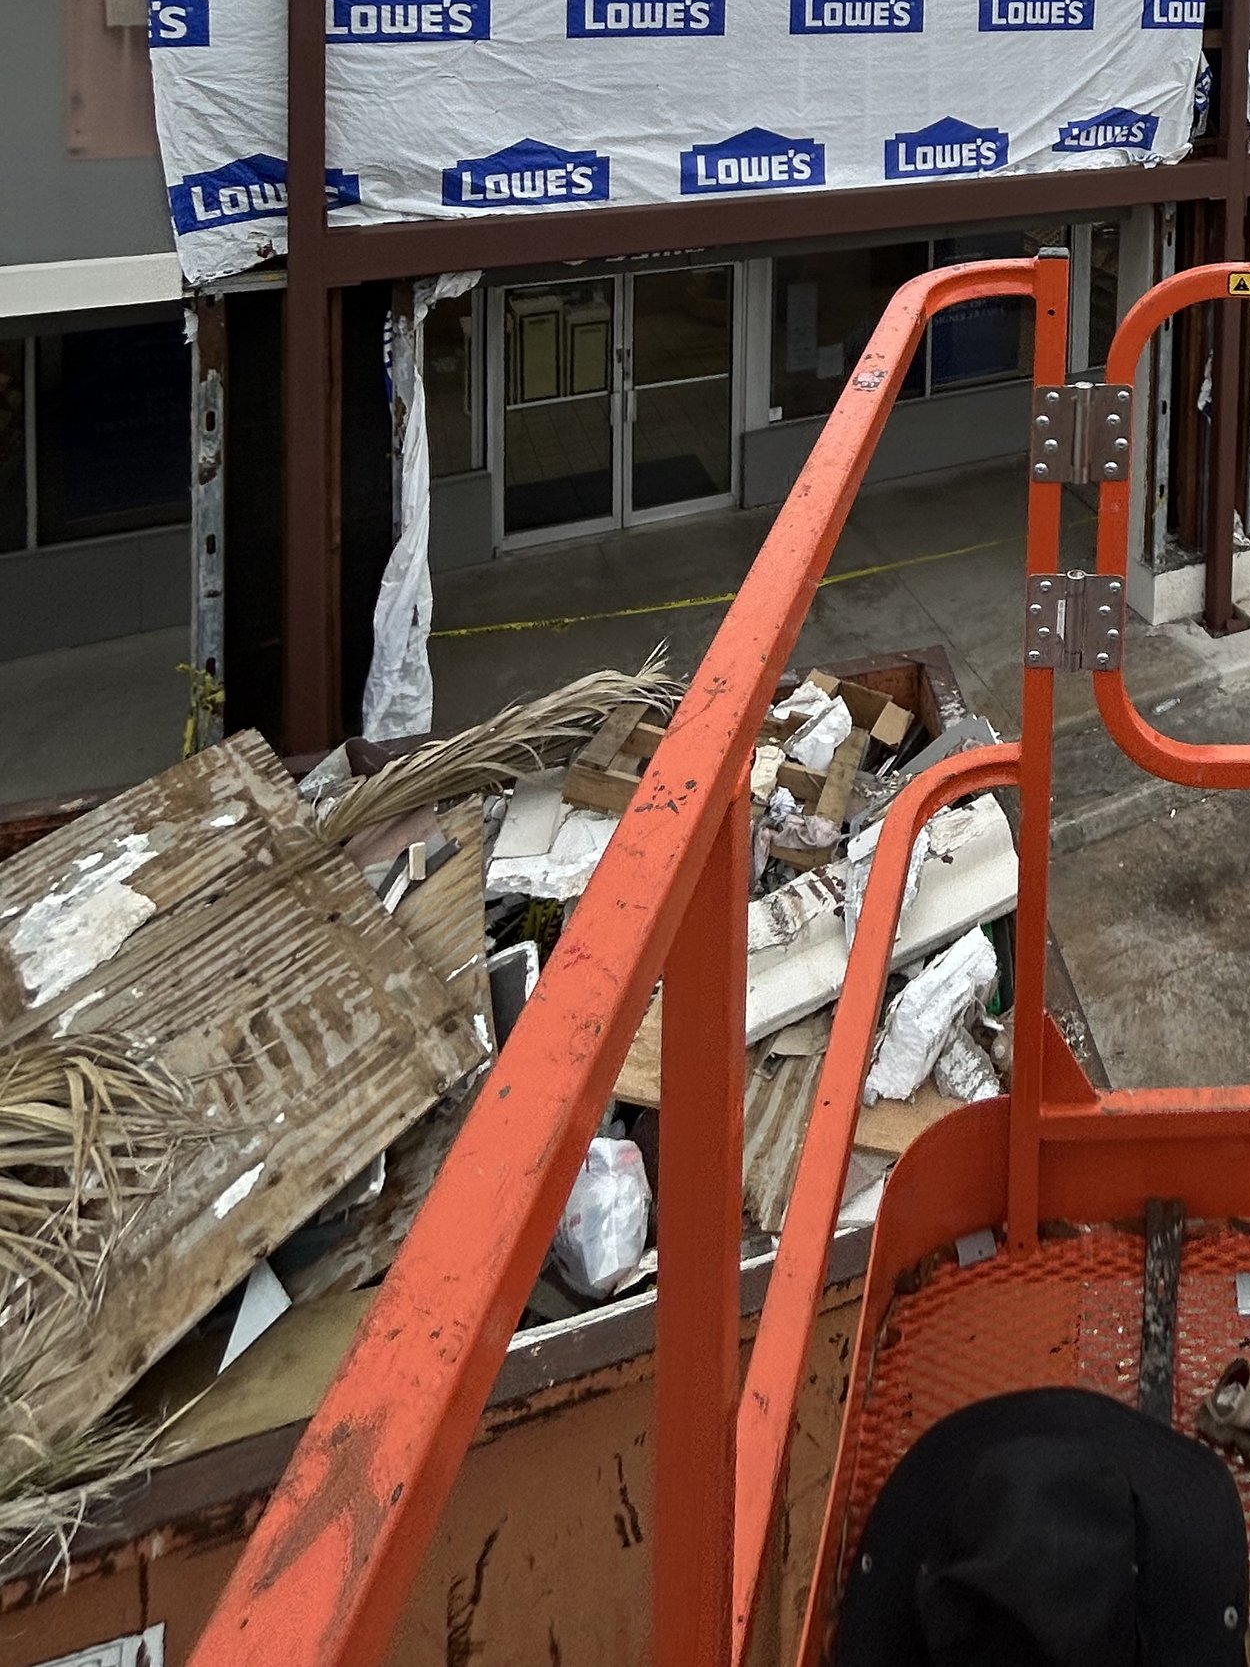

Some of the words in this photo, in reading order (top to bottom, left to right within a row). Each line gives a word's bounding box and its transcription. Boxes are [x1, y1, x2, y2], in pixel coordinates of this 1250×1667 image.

[697, 150, 812, 186] LOWE'S
[899, 138, 997, 172] LOWE'S
[461, 163, 593, 201] LOWE'S
